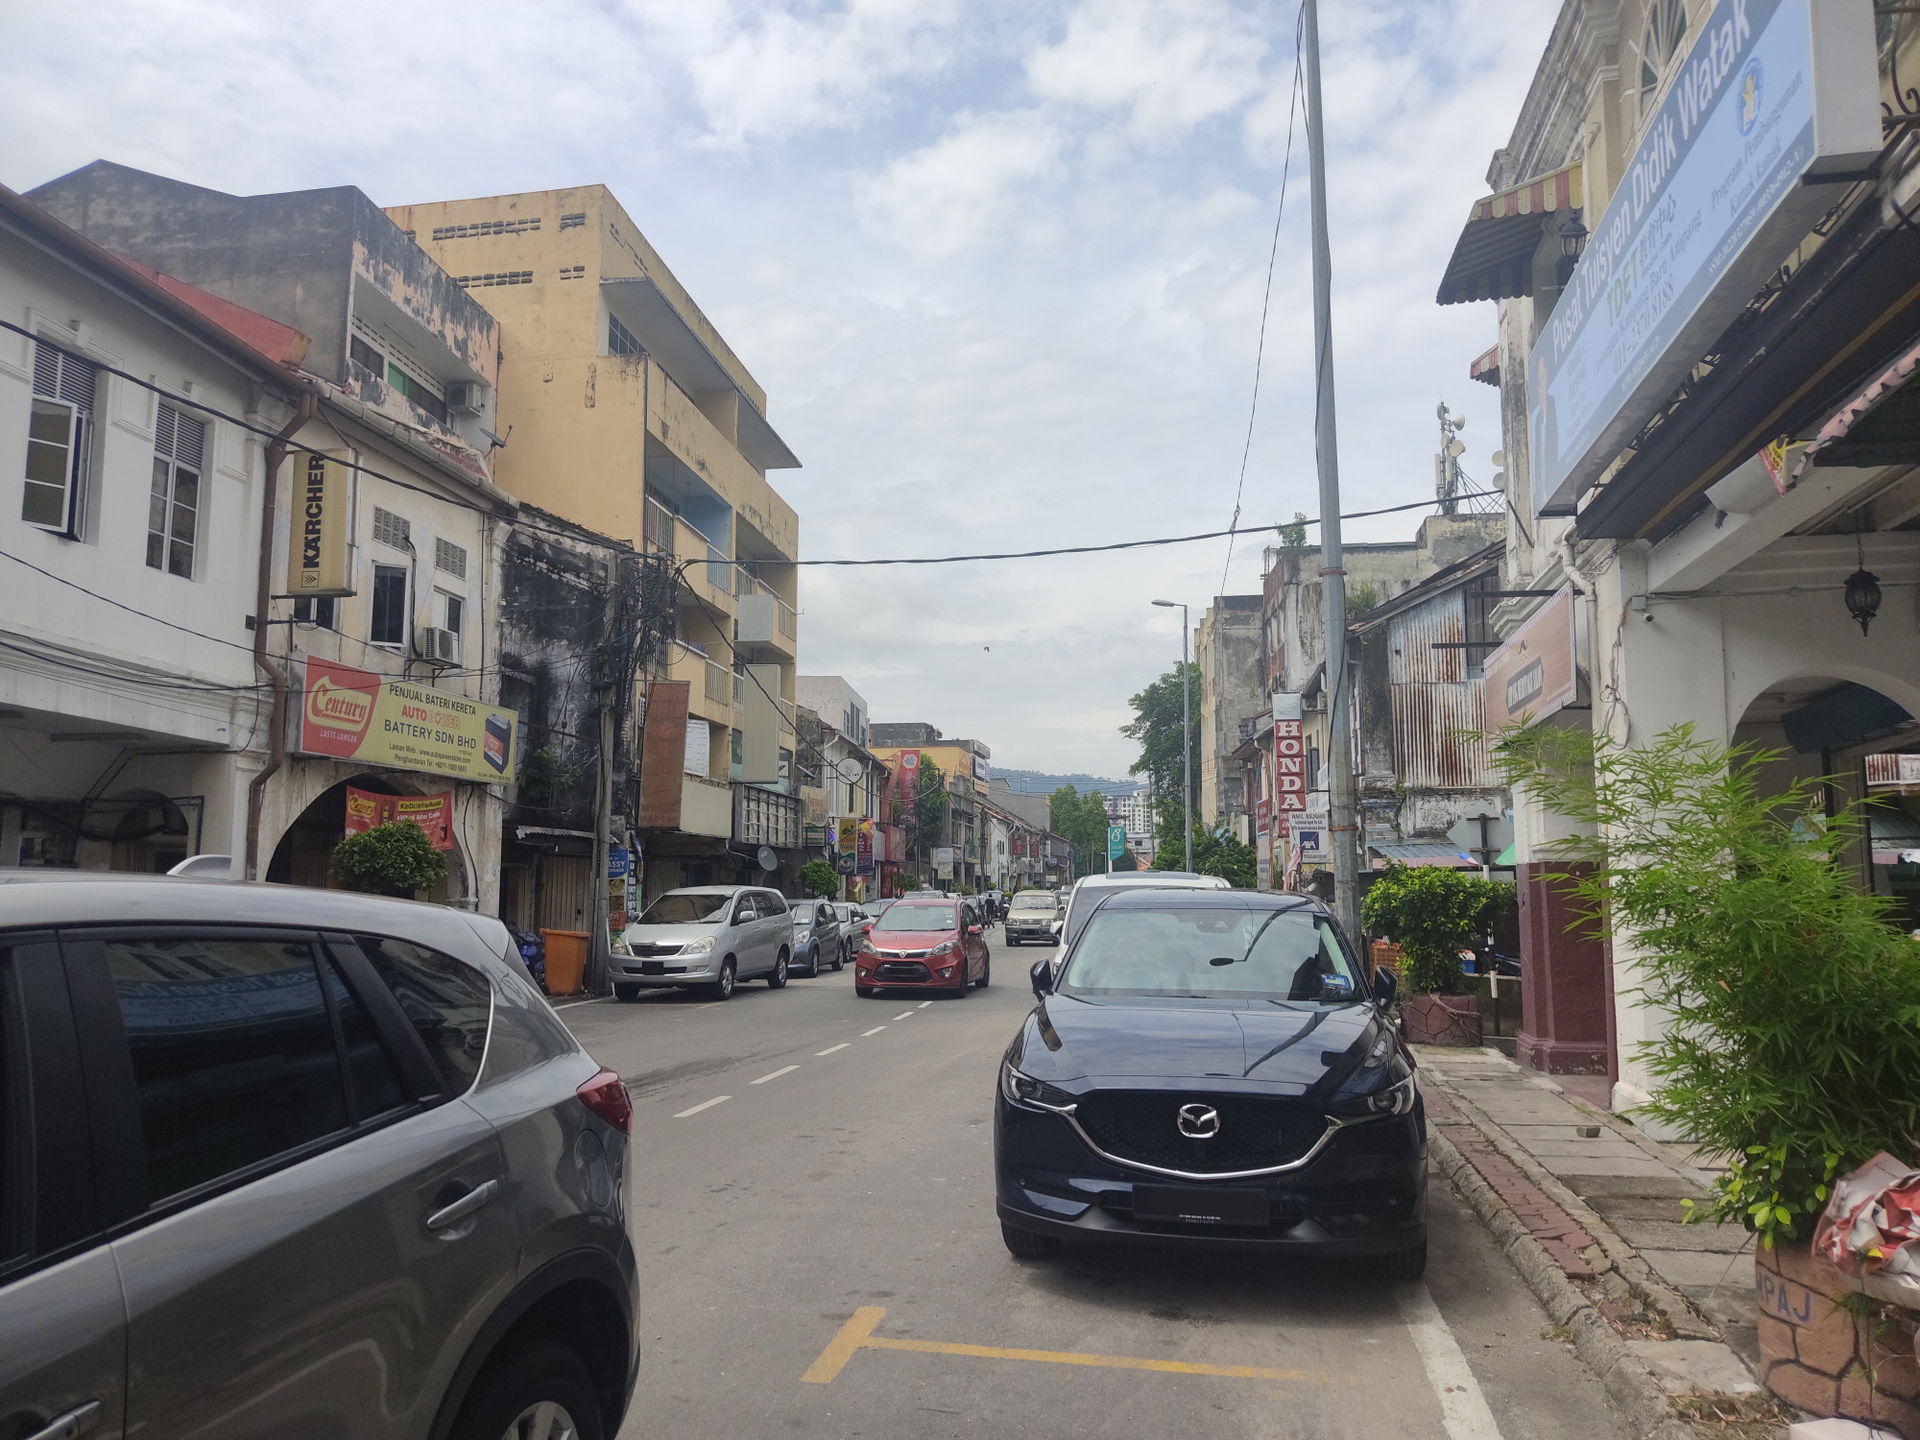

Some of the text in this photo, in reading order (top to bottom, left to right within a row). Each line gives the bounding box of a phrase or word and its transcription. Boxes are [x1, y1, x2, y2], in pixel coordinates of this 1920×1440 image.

[1553, 282, 1583, 365] Pusat
[1581, 199, 1631, 310] Tuisyen
[1632, 113, 1677, 222] Didik
[1677, 0, 1750, 141] Watak
[1607, 250, 1639, 327] TDET
[303, 455, 325, 568] KÄRCHER
[311, 683, 368, 724] Century
[389, 684, 476, 716] PENJUAL BATERI KERETA
[320, 729, 336, 740] LASTS
[384, 719, 477, 749] BATTERY SDN BHD
[1277, 721, 1303, 809] HONDA
